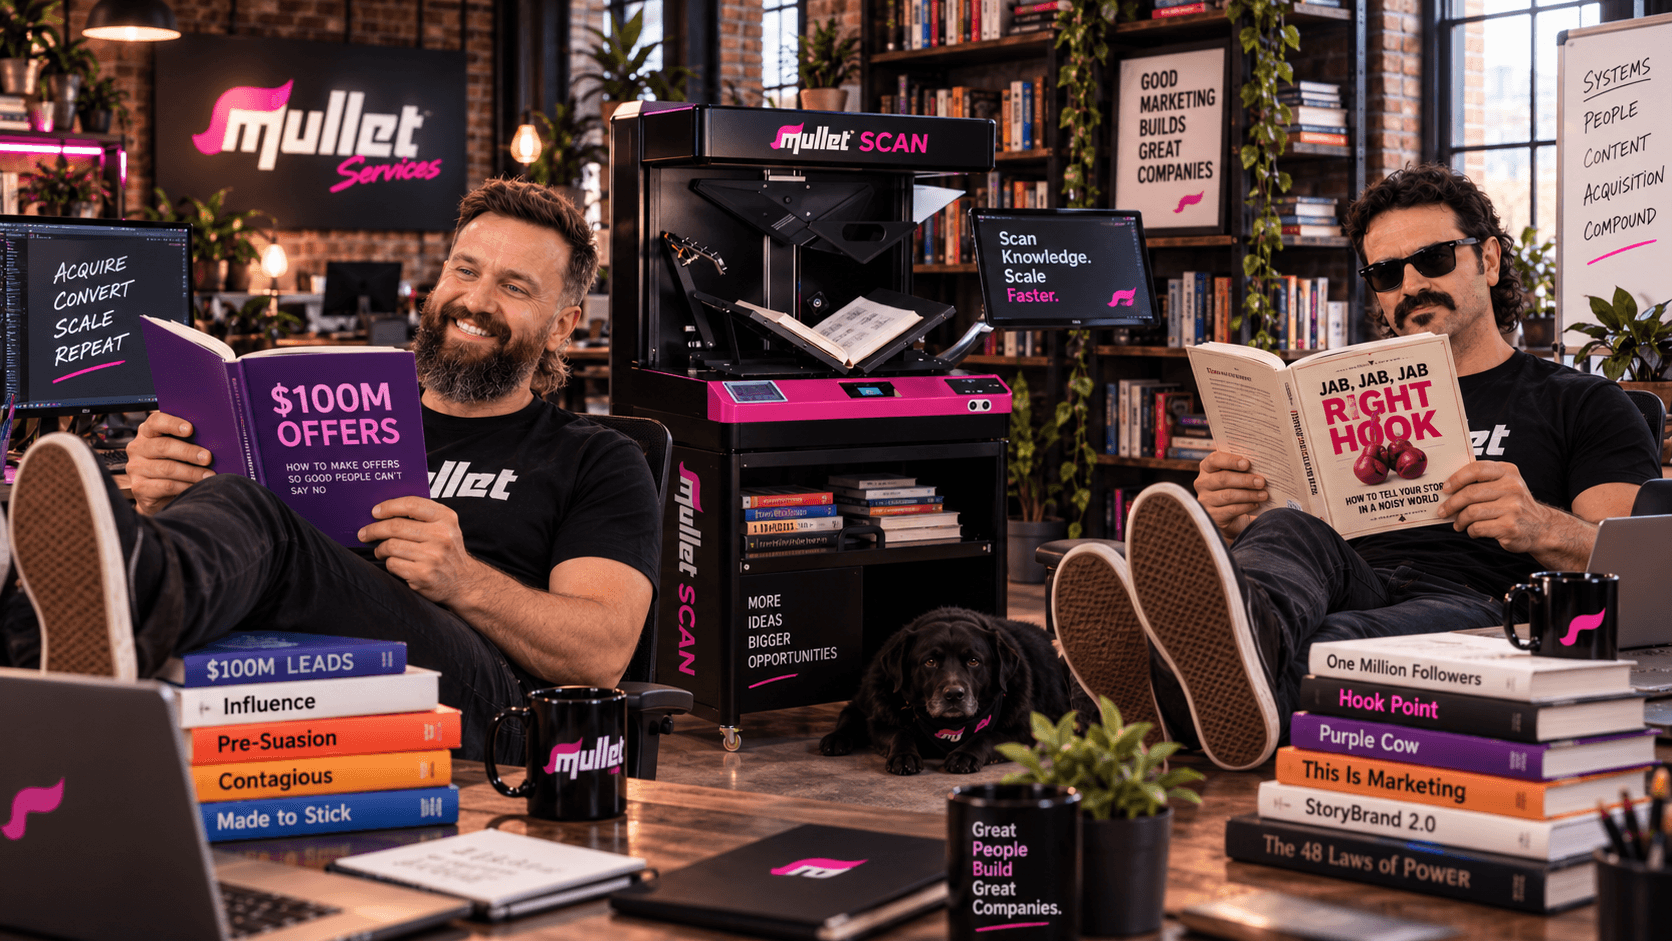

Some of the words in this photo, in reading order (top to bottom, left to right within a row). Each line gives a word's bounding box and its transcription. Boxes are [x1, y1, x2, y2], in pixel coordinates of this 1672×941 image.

[1141, 69, 1178, 91] GOOD
[1583, 57, 1651, 94] SYSTEMS
[1139, 88, 1216, 114] MARKETING
[1139, 115, 1186, 137] BUILDS
[1584, 100, 1639, 134] PEOPLE
[859, 131, 929, 154] SCAN
[1138, 139, 1182, 161] GREAT
[1583, 133, 1652, 169] CONTENT
[329, 154, 443, 193] Services
[1137, 161, 1214, 184] COMPANIES
[1583, 207, 1657, 241] COMPOUND
[999, 230, 1037, 247] Scan
[53, 255, 128, 284] ACQUIRE
[1002, 249, 1092, 267] Knowledge.
[1004, 268, 1047, 284] Scale
[53, 279, 136, 310] CONVERT
[1007, 287, 1060, 303] Faster.
[53, 310, 115, 339] SCALE
[54, 332, 130, 366] REPEAT
[1319, 377, 1355, 396] JAB,
[1358, 370, 1394, 388] JAB,
[1397, 363, 1429, 381] JAB
[270, 382, 392, 417] $100M
[1321, 380, 1432, 426] RIGHT
[277, 417, 401, 448] OFFERS
[1329, 409, 1443, 455] HOOK
[286, 462, 310, 472] HOW
[313, 461, 328, 471] TO
[330, 460, 359, 471] MAKE
[362, 459, 400, 470] OFFERS
[288, 474, 302, 484] SO
[304, 473, 333, 483] GOOD
[335, 471, 371, 482] PEOPLE
[375, 470, 402, 480] CAN'T
[290, 486, 310, 496] SAY
[312, 485, 326, 495] NO
[1345, 494, 1365, 506] HOW
[1366, 492, 1378, 502] TO
[1379, 489, 1398, 500] TELL
[1398, 485, 1422, 496] YOUR
[1423, 482, 1444, 493] STOR
[1358, 505, 1369, 514] IN
[1370, 503, 1377, 513] A
[1378, 499, 1406, 511] NOISY
[1407, 493, 1439, 506] WORLD
[748, 593, 781, 610] MORE
[678, 583, 696, 677] SCAN
[748, 613, 783, 630] IDEAS
[748, 632, 791, 649] BIGGER
[206, 656, 276, 682] $100M
[286, 652, 355, 676] LEADS
[748, 646, 838, 669] OPPORTUNITIES
[1326, 653, 1355, 671] One
[1359, 657, 1407, 678] Million
[1412, 663, 1482, 686] Followers
[224, 695, 316, 715] Influence
[1339, 688, 1385, 713] Hook
[1390, 695, 1439, 720] Point
[217, 730, 337, 753] Pre-Suasion
[1319, 723, 1375, 751] Purple
[1381, 732, 1420, 755] Cow
[218, 767, 333, 791] Contagious
[1302, 760, 1340, 783] This
[1346, 764, 1361, 785] Is
[1367, 768, 1467, 804] Marketing
[216, 810, 270, 831] Made
[277, 809, 298, 827] to
[304, 803, 352, 825] Stick
[1304, 797, 1402, 828] StoryBrand
[1408, 813, 1437, 834] 2.0
[972, 820, 1017, 839] Great
[972, 841, 1029, 861] People
[1262, 833, 1296, 859] The
[1300, 841, 1323, 864] 48
[1328, 844, 1374, 873] Laws
[1378, 849, 1400, 876] of
[1403, 860, 1471, 889] POWER
[972, 861, 1013, 878] Build
[972, 879, 1017, 897] Great
[972, 899, 1063, 919] Companies.
